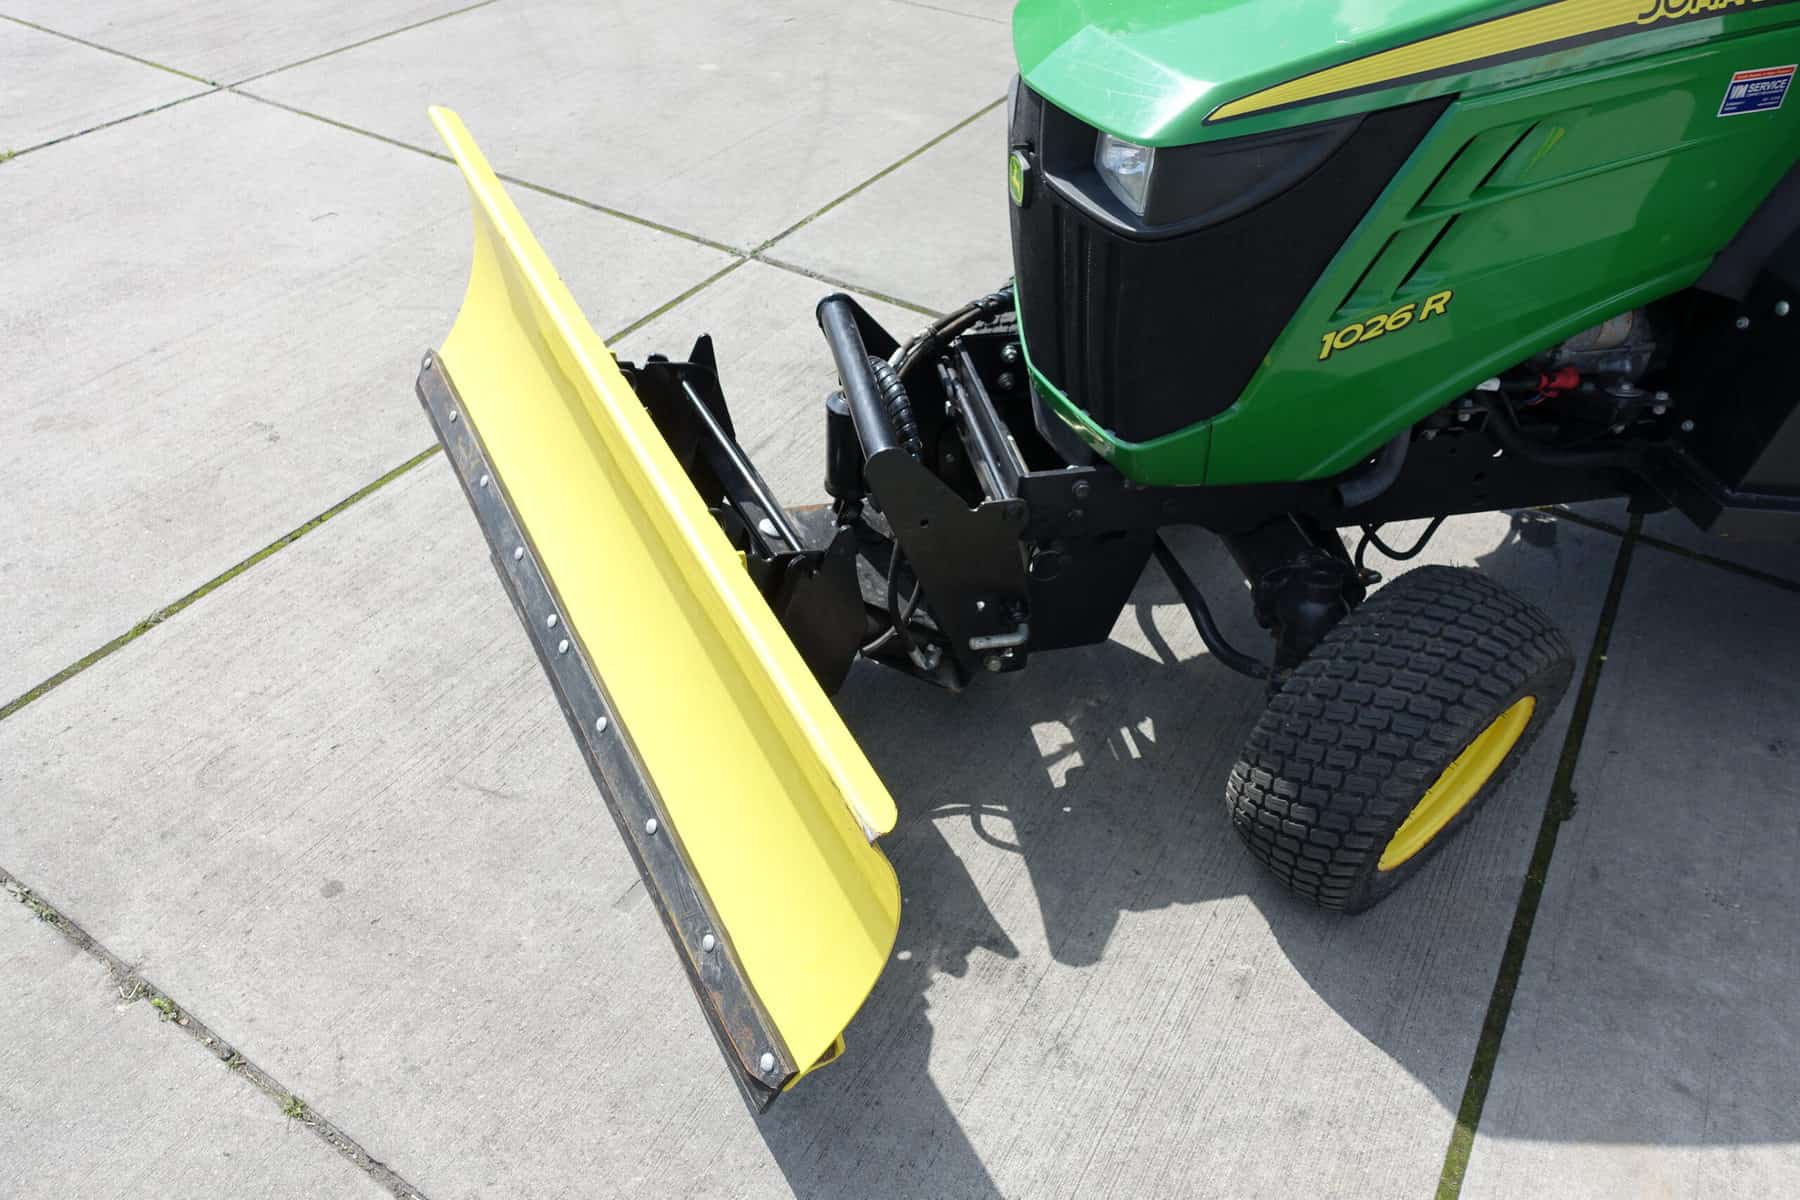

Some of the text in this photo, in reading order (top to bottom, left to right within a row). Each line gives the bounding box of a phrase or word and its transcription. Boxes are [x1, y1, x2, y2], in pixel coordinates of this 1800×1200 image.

[1747, 79, 1788, 93] SERVICE
[1318, 289, 1454, 361] 1026 R
